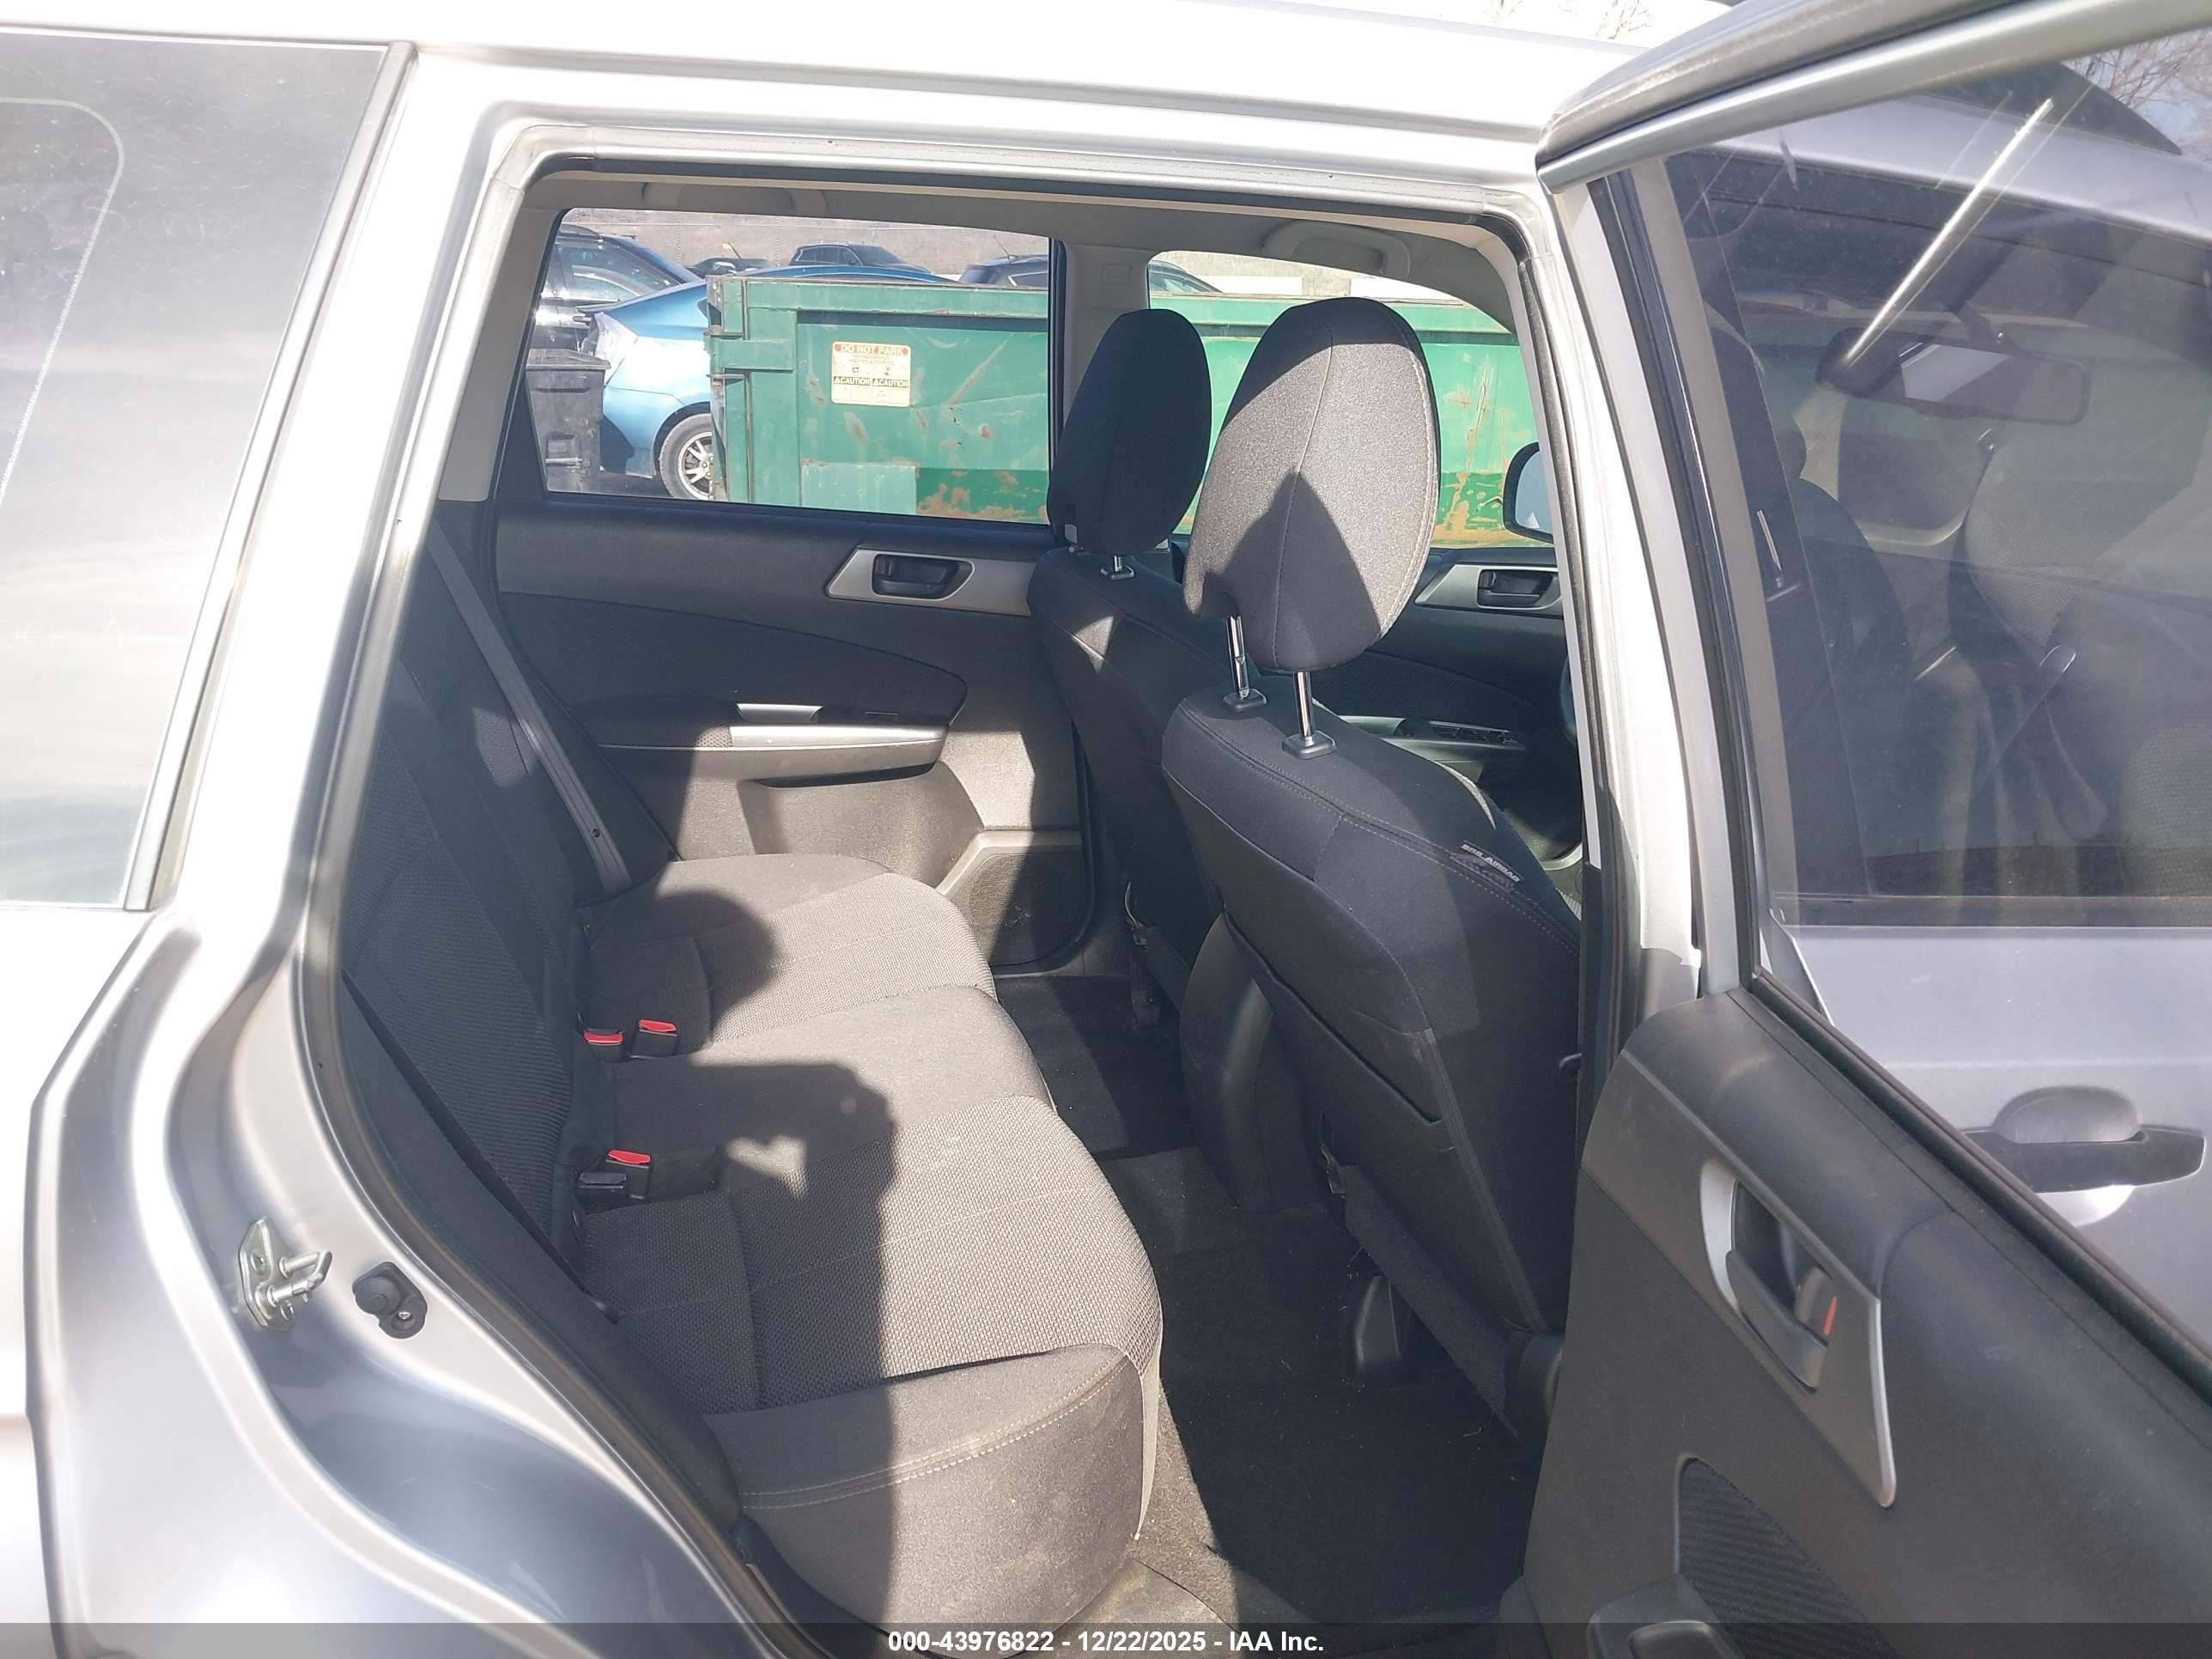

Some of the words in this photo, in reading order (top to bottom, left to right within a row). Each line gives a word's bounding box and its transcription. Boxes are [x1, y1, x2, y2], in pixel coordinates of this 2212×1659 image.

[841, 344, 855, 353] DO
[857, 345, 877, 354] NOT
[879, 346, 903, 356] PARK
[878, 379, 908, 387] CAUTION
[1484, 856, 1521, 883] AIRBAG
